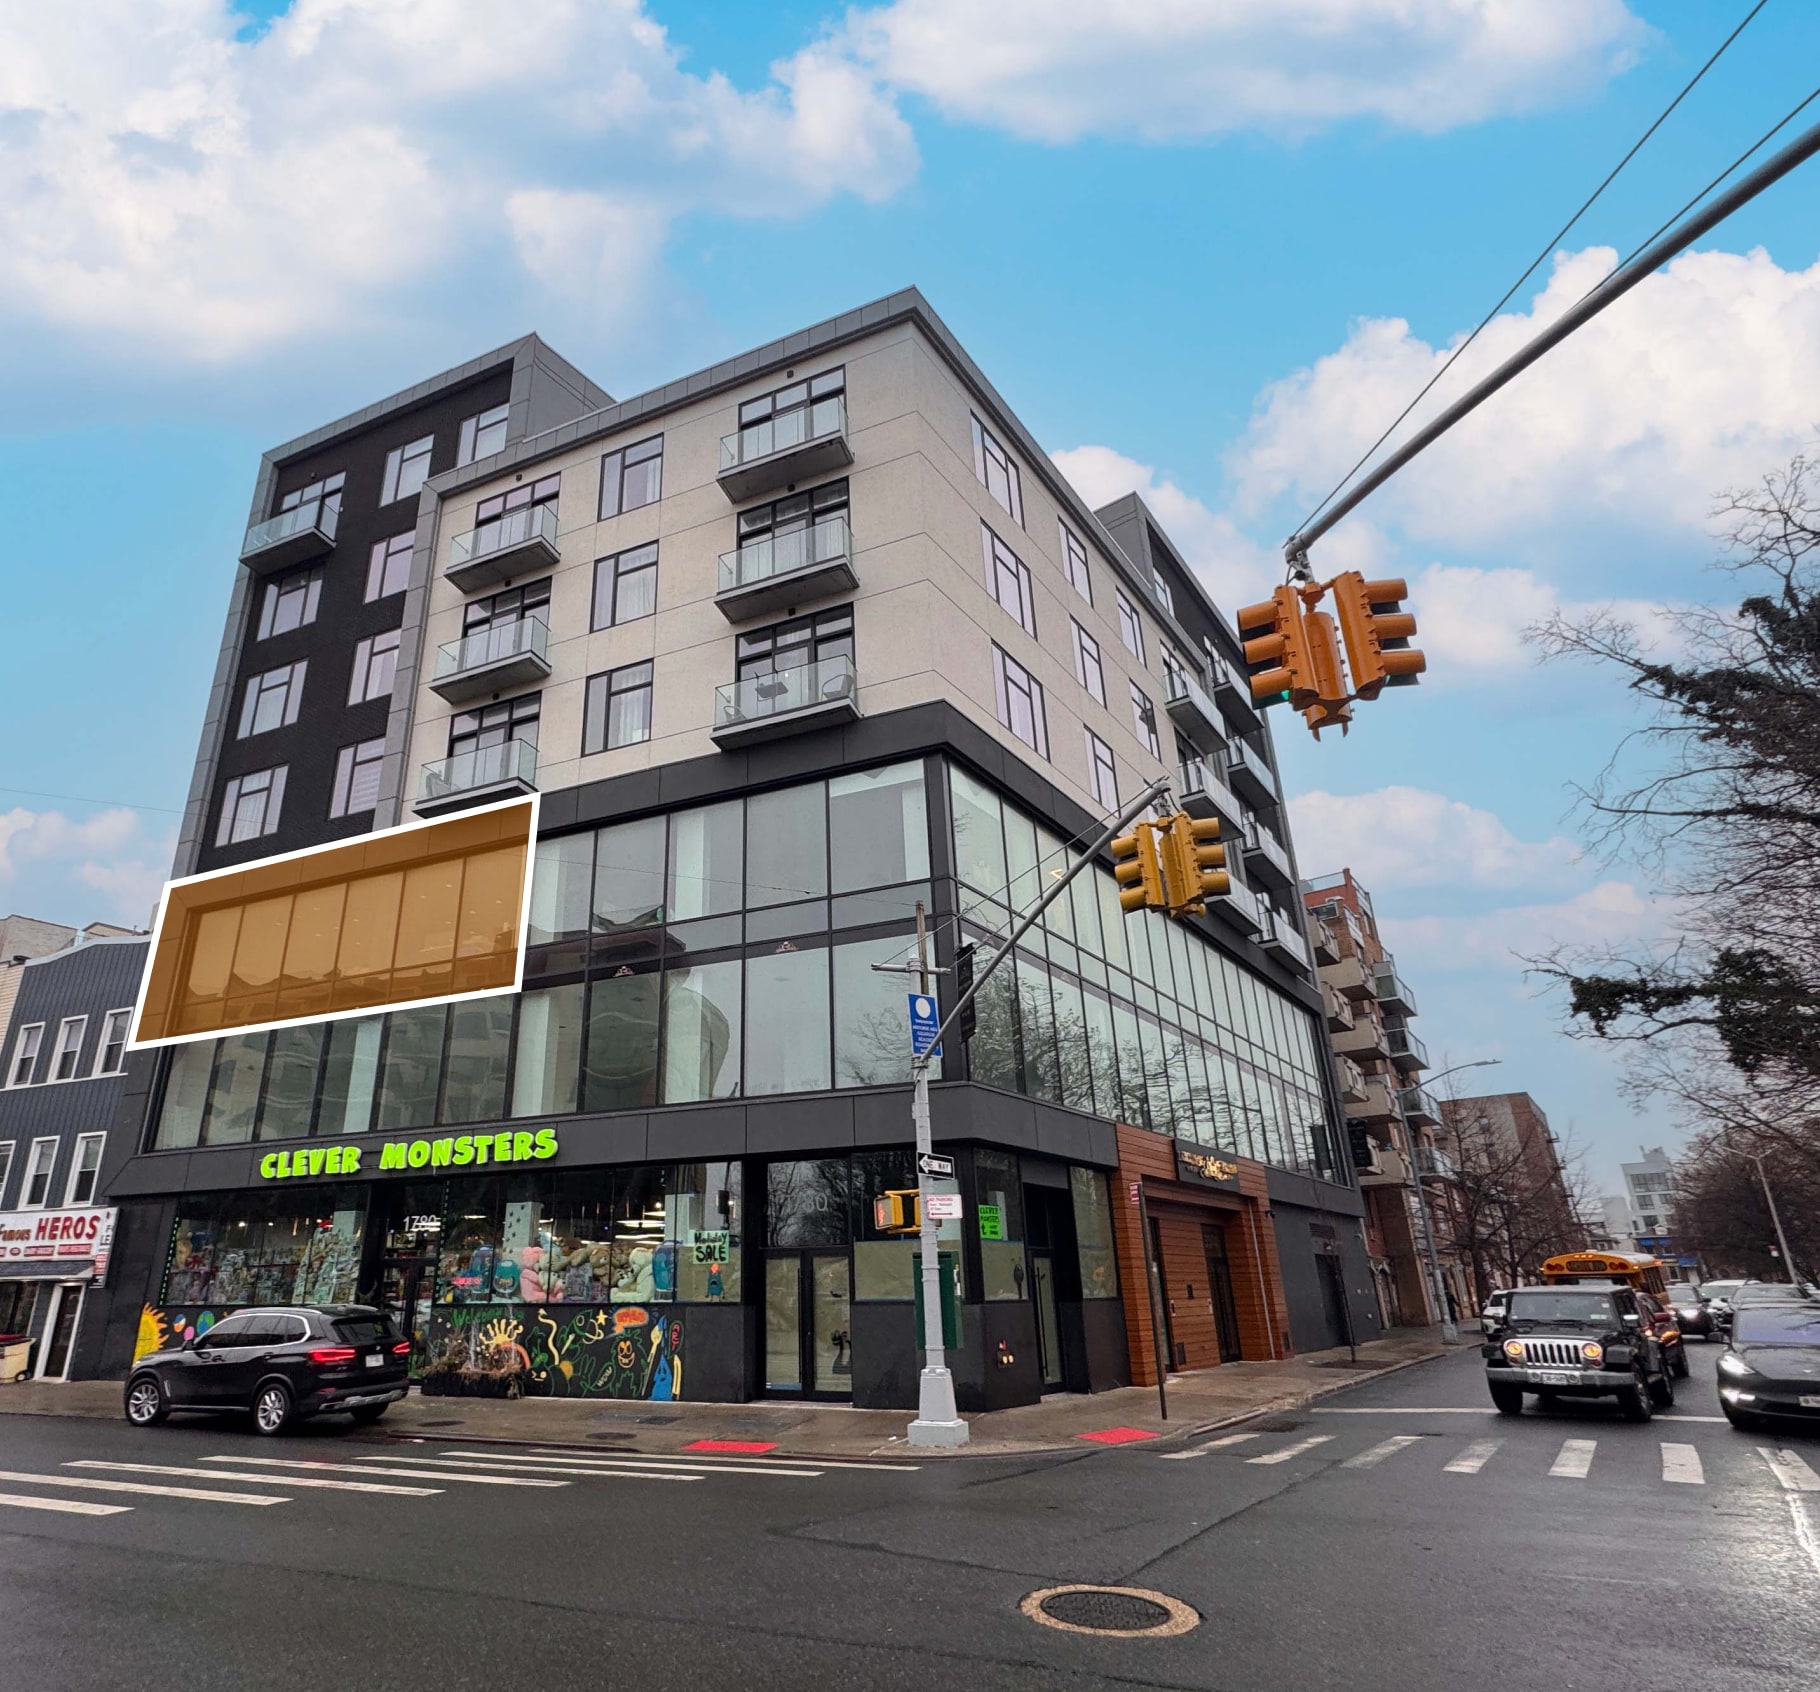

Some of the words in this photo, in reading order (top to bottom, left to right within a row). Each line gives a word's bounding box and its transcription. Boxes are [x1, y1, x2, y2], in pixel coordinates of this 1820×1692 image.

[260, 1146, 362, 1179] CLEVER
[379, 1128, 558, 1170] MONSTERS
[922, 1159, 934, 1169] ONE
[938, 1162, 950, 1170] WAY
[35, 1215, 101, 1240] HEROS
[403, 1215, 436, 1232] 1780
[695, 1245, 727, 1263] SALE
